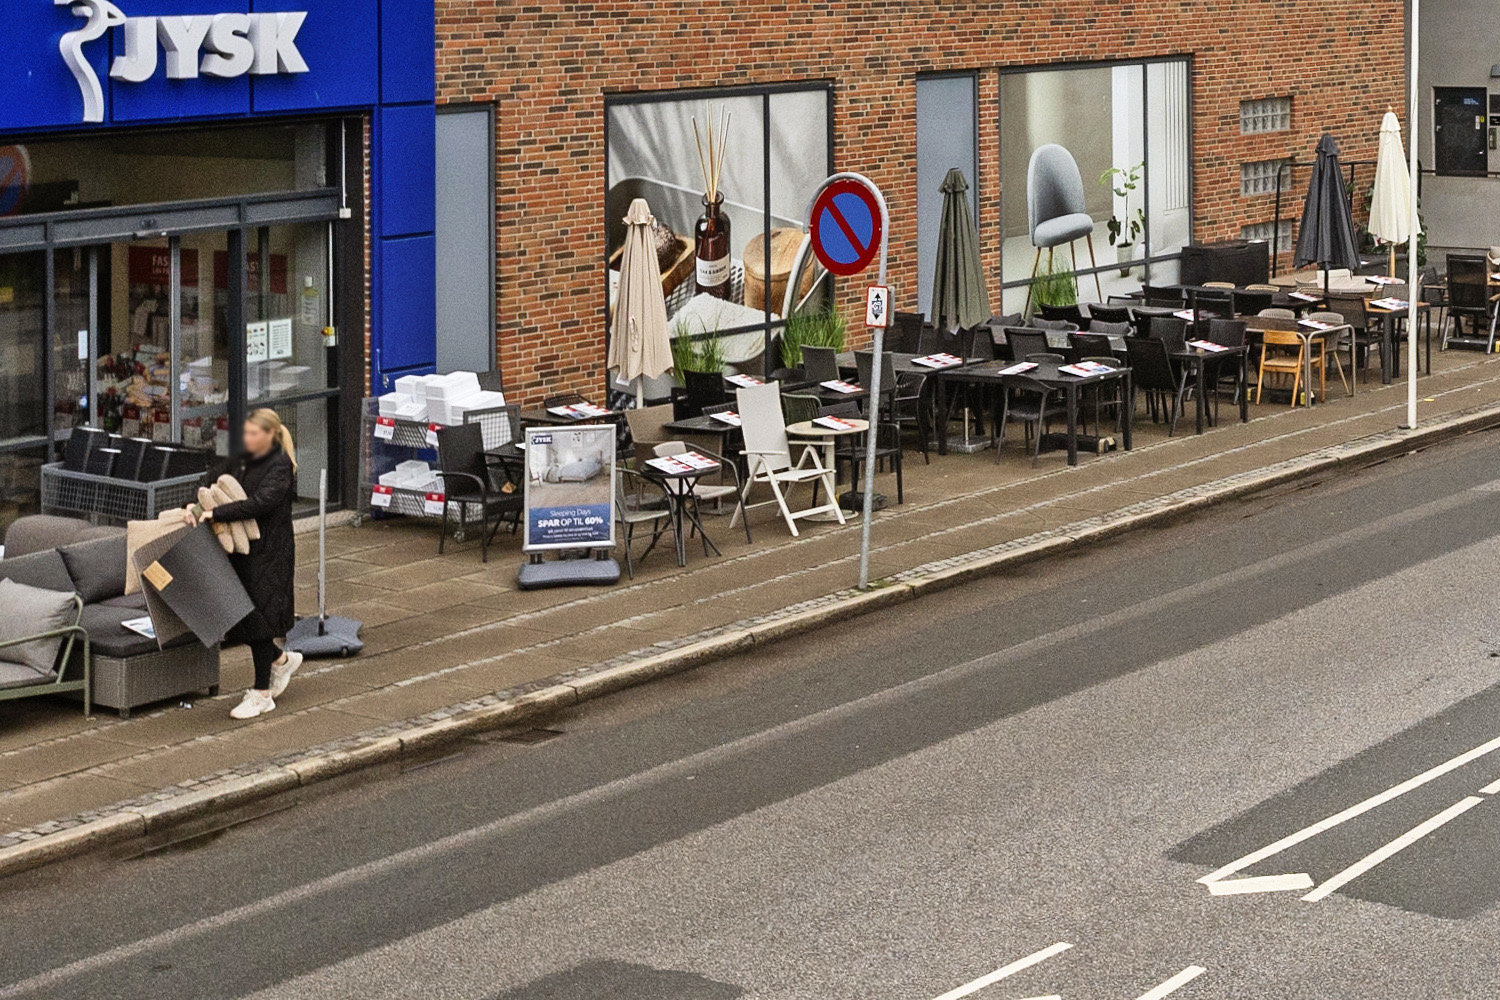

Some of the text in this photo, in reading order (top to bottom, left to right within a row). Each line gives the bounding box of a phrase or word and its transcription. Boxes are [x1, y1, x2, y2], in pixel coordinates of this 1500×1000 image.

[109, 11, 310, 82] JYSK
[152, 255, 169, 266] FAS
[549, 508, 591, 517] Sleeping Days
[537, 516, 604, 528] SPAR OP TIL 60%
